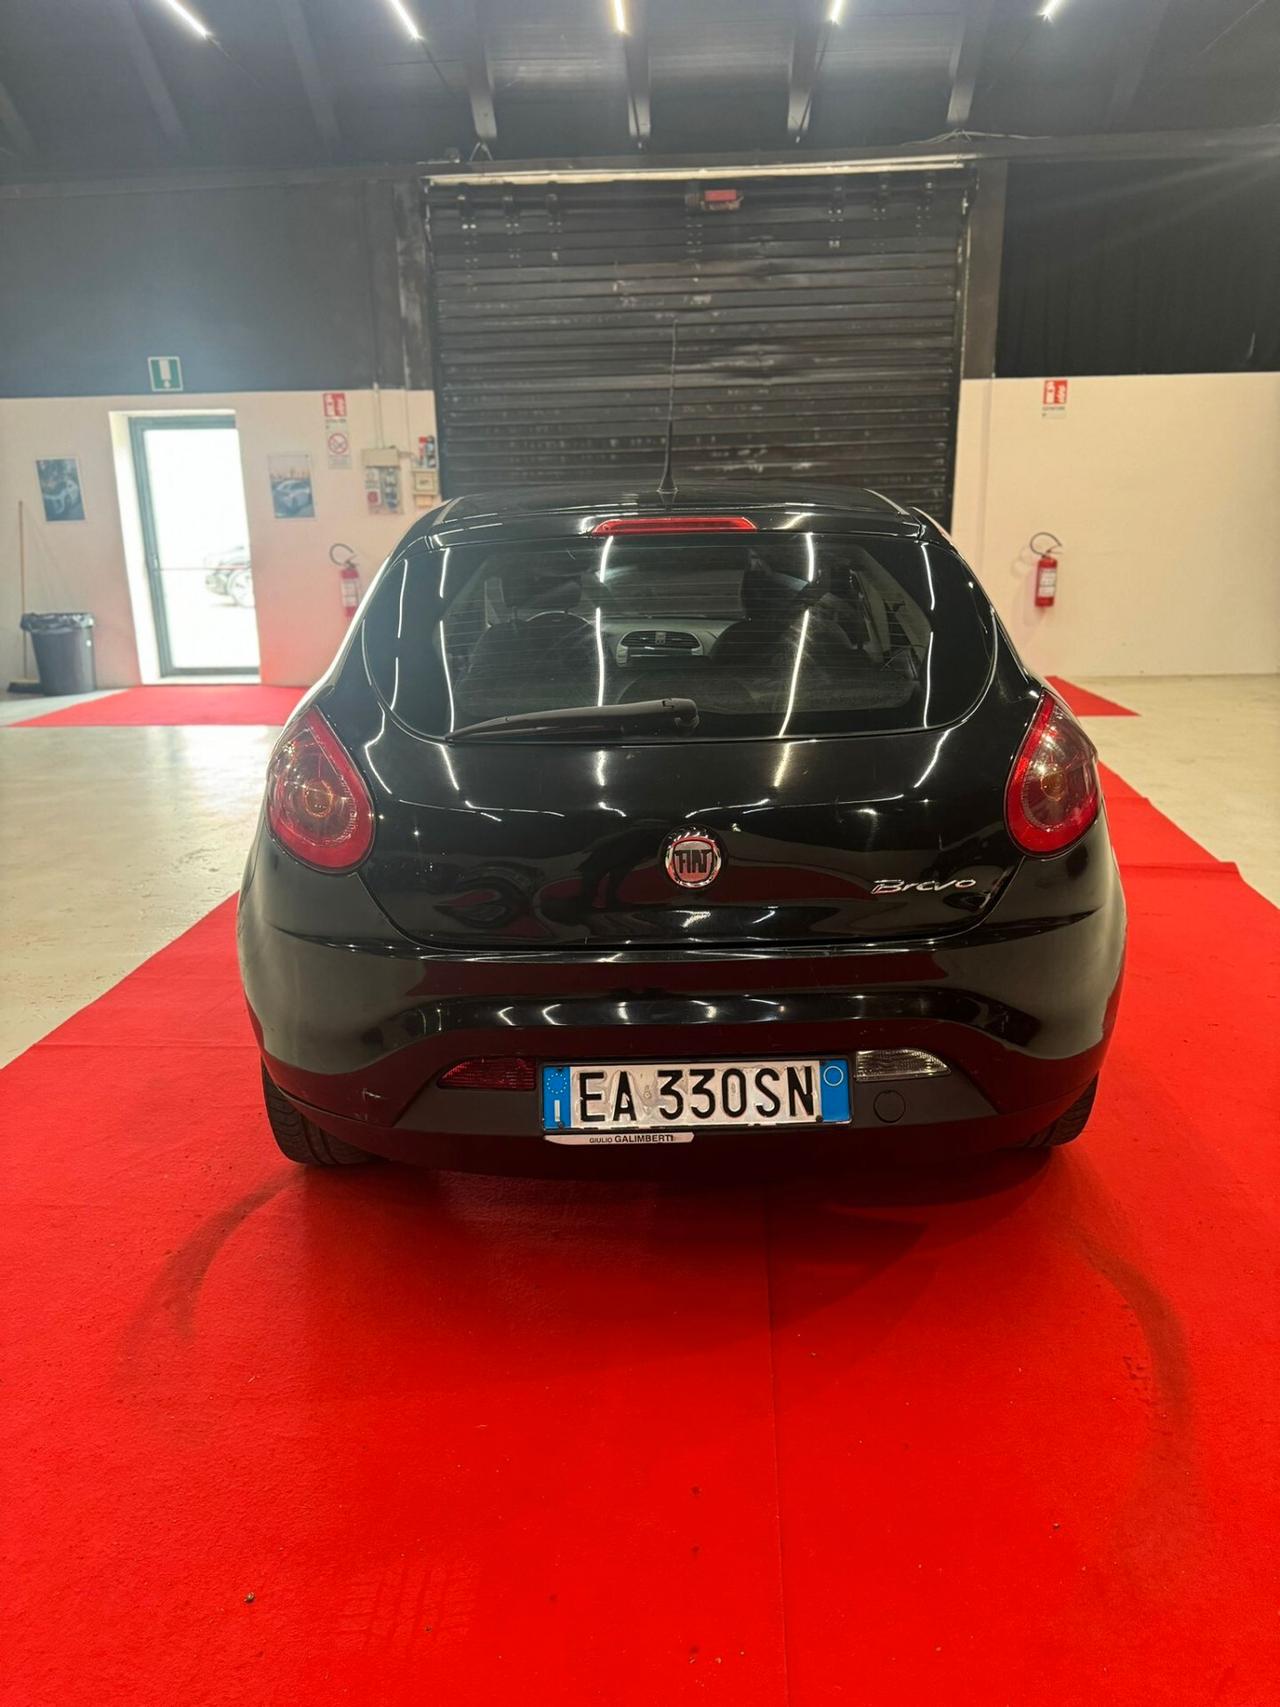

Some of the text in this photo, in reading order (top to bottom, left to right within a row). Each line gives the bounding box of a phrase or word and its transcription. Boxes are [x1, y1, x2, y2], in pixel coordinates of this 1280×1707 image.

[674, 849, 713, 873] FIAT
[871, 879, 976, 894] Bravo
[579, 1065, 815, 1122] EA 330SN
[614, 1134, 674, 1144] GALIMBERTI
